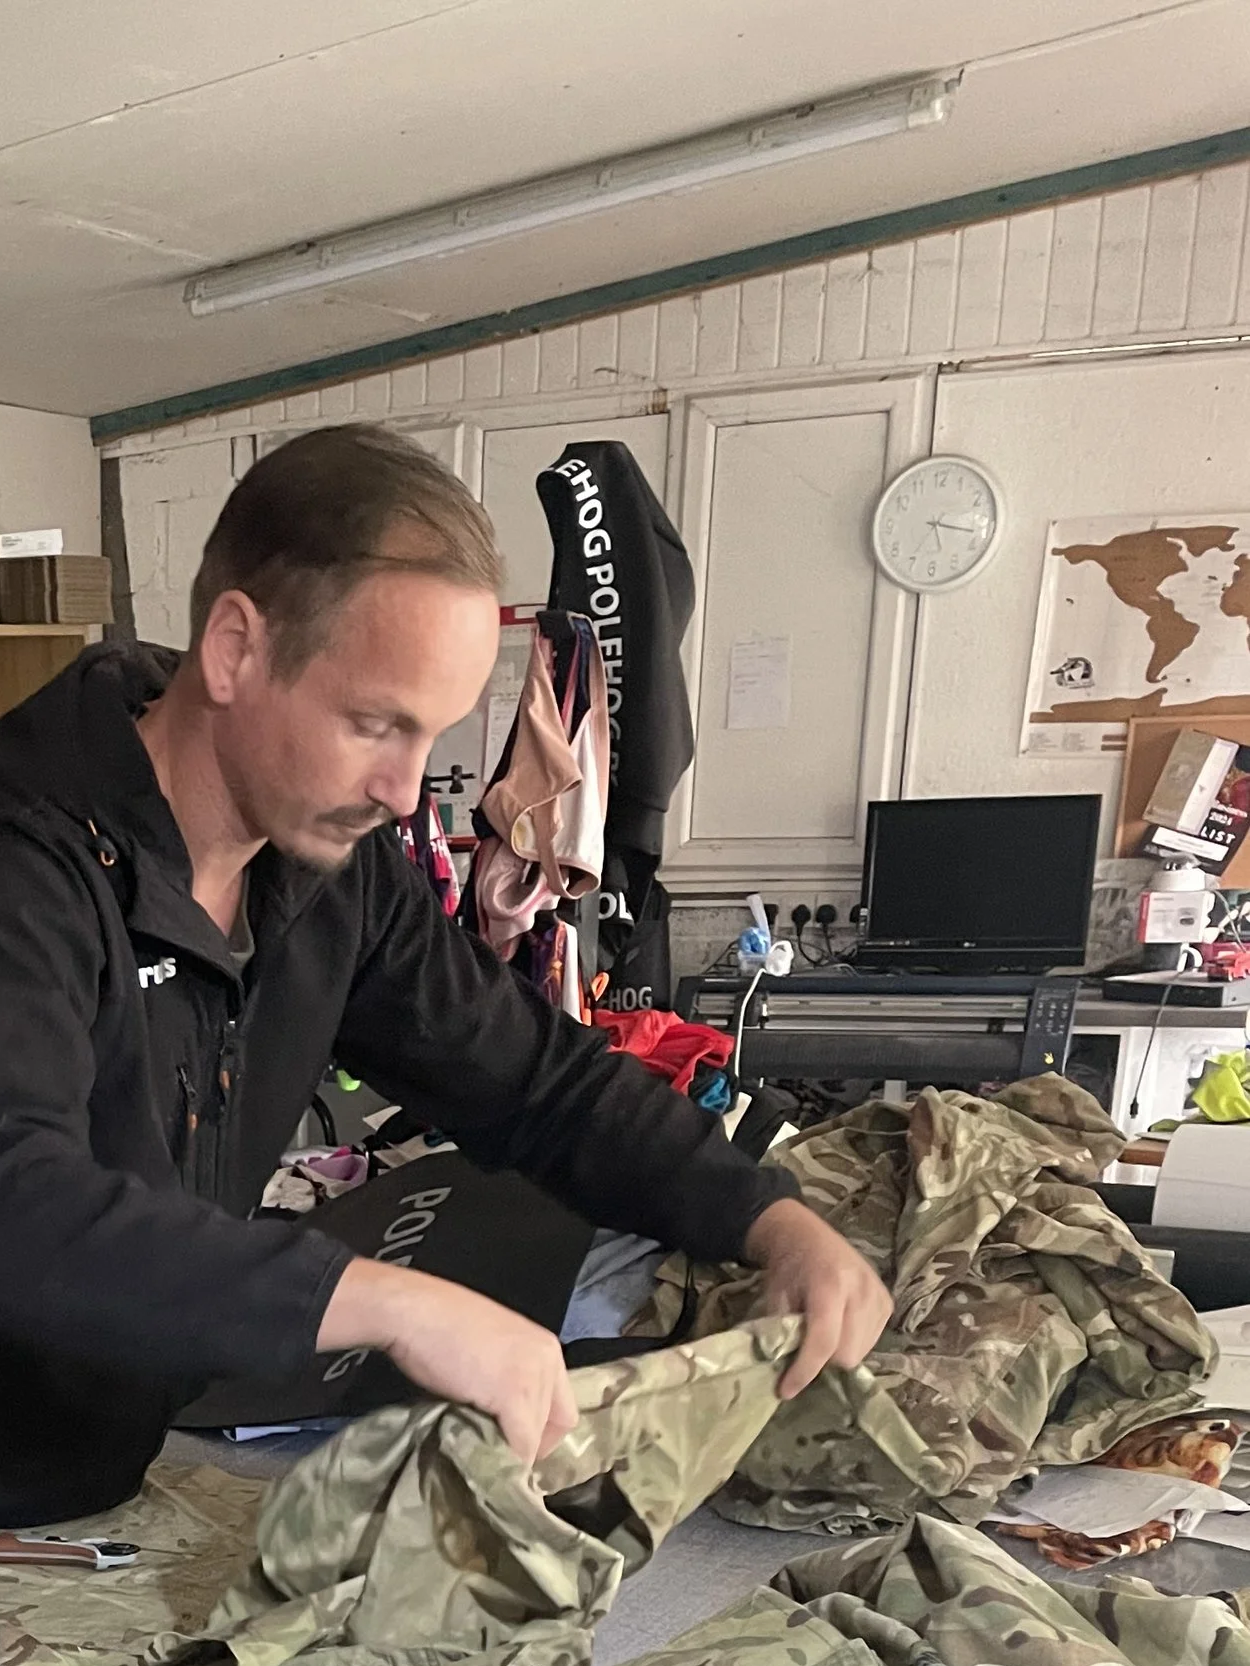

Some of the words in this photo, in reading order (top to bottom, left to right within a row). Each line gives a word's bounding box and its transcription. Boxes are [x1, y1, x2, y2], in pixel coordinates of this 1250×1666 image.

[912, 479, 924, 494] 11
[934, 471, 949, 489] 12
[896, 494, 910, 512] 10
[973, 489, 982, 507] 2
[909, 555, 916, 572] 7
[927, 560, 936, 577] 6
[1200, 825, 1236, 845] LIST
[602, 985, 653, 1011] HOG
